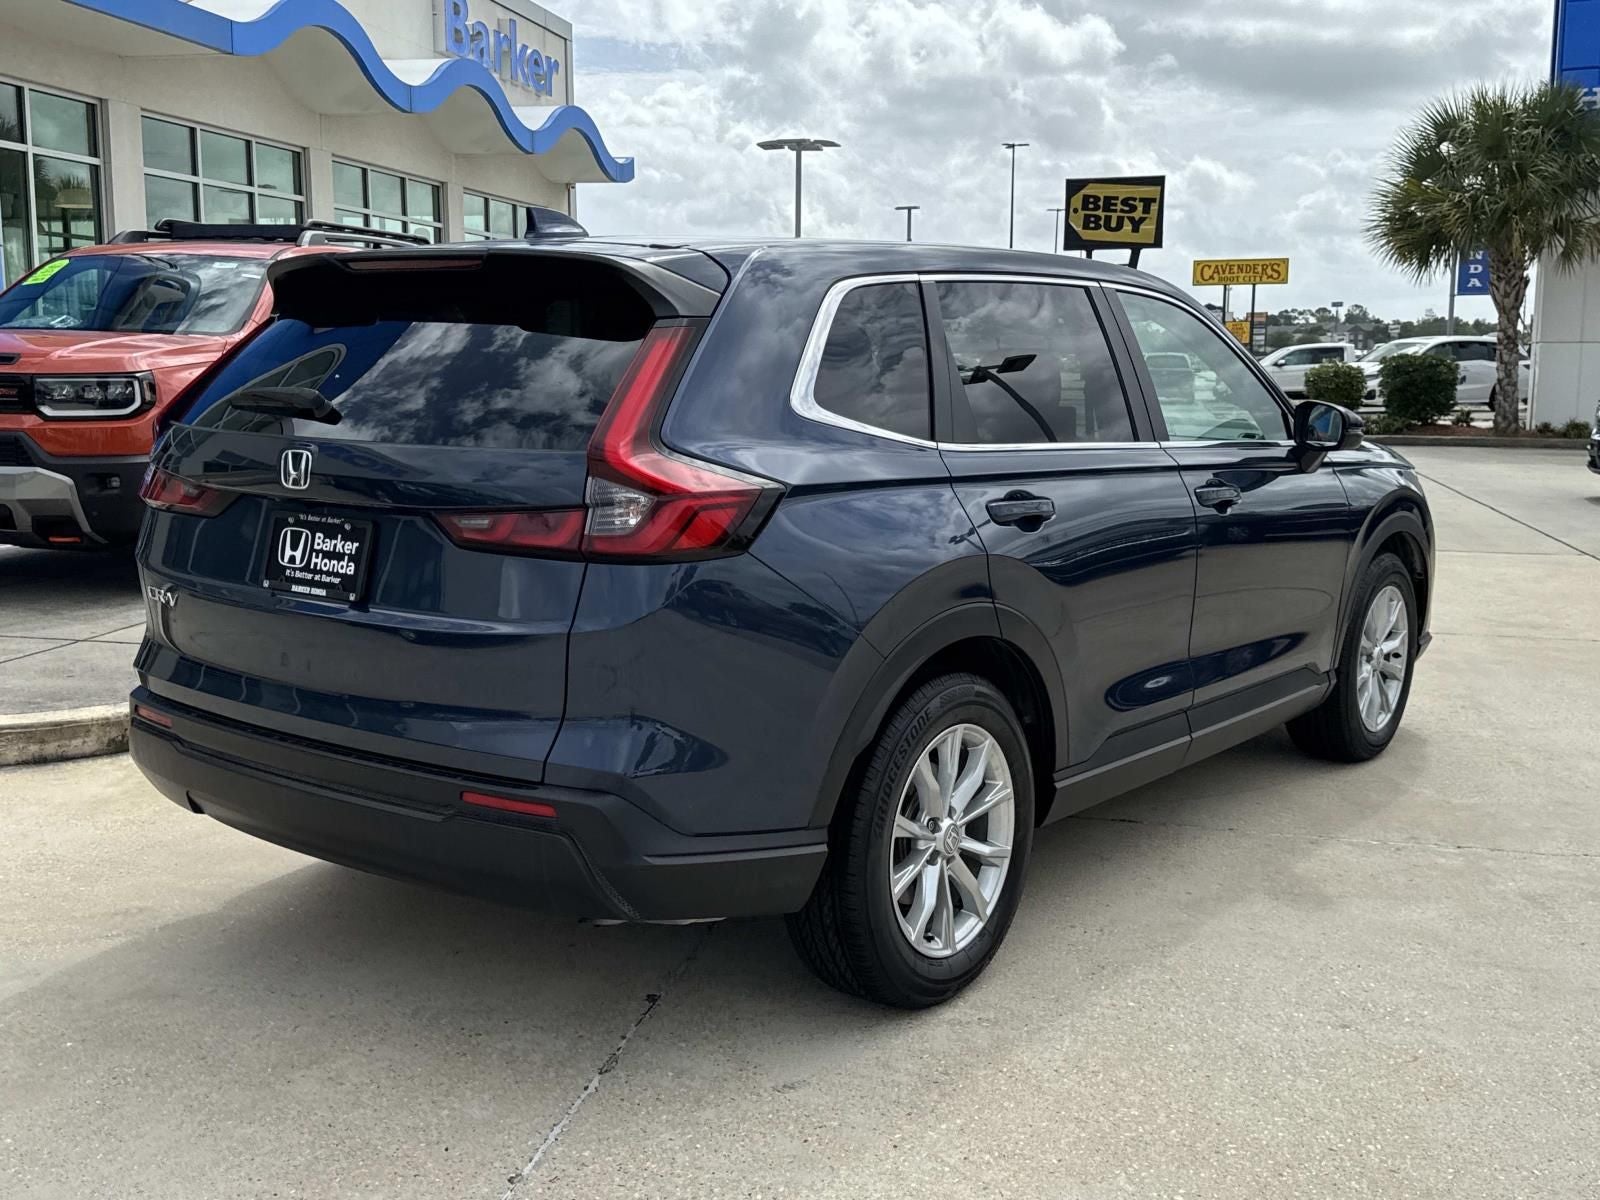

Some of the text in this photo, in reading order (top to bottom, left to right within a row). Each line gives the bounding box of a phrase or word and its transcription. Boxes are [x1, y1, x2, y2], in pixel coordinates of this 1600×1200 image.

[445, 0, 560, 97] Barker
[1080, 194, 1157, 215] BEST
[1082, 213, 1147, 234] BUY
[1200, 262, 1281, 282] CAVENDER'S
[1218, 275, 1240, 283] BOOT
[313, 532, 359, 555] Barker
[310, 552, 355, 575] Honda
[285, 568, 295, 577] It's
[295, 570, 313, 580] Better
[321, 575, 341, 584] Barker
[291, 585, 327, 596] BARKER HONDA
[873, 706, 934, 837] BRIDGESTONE
